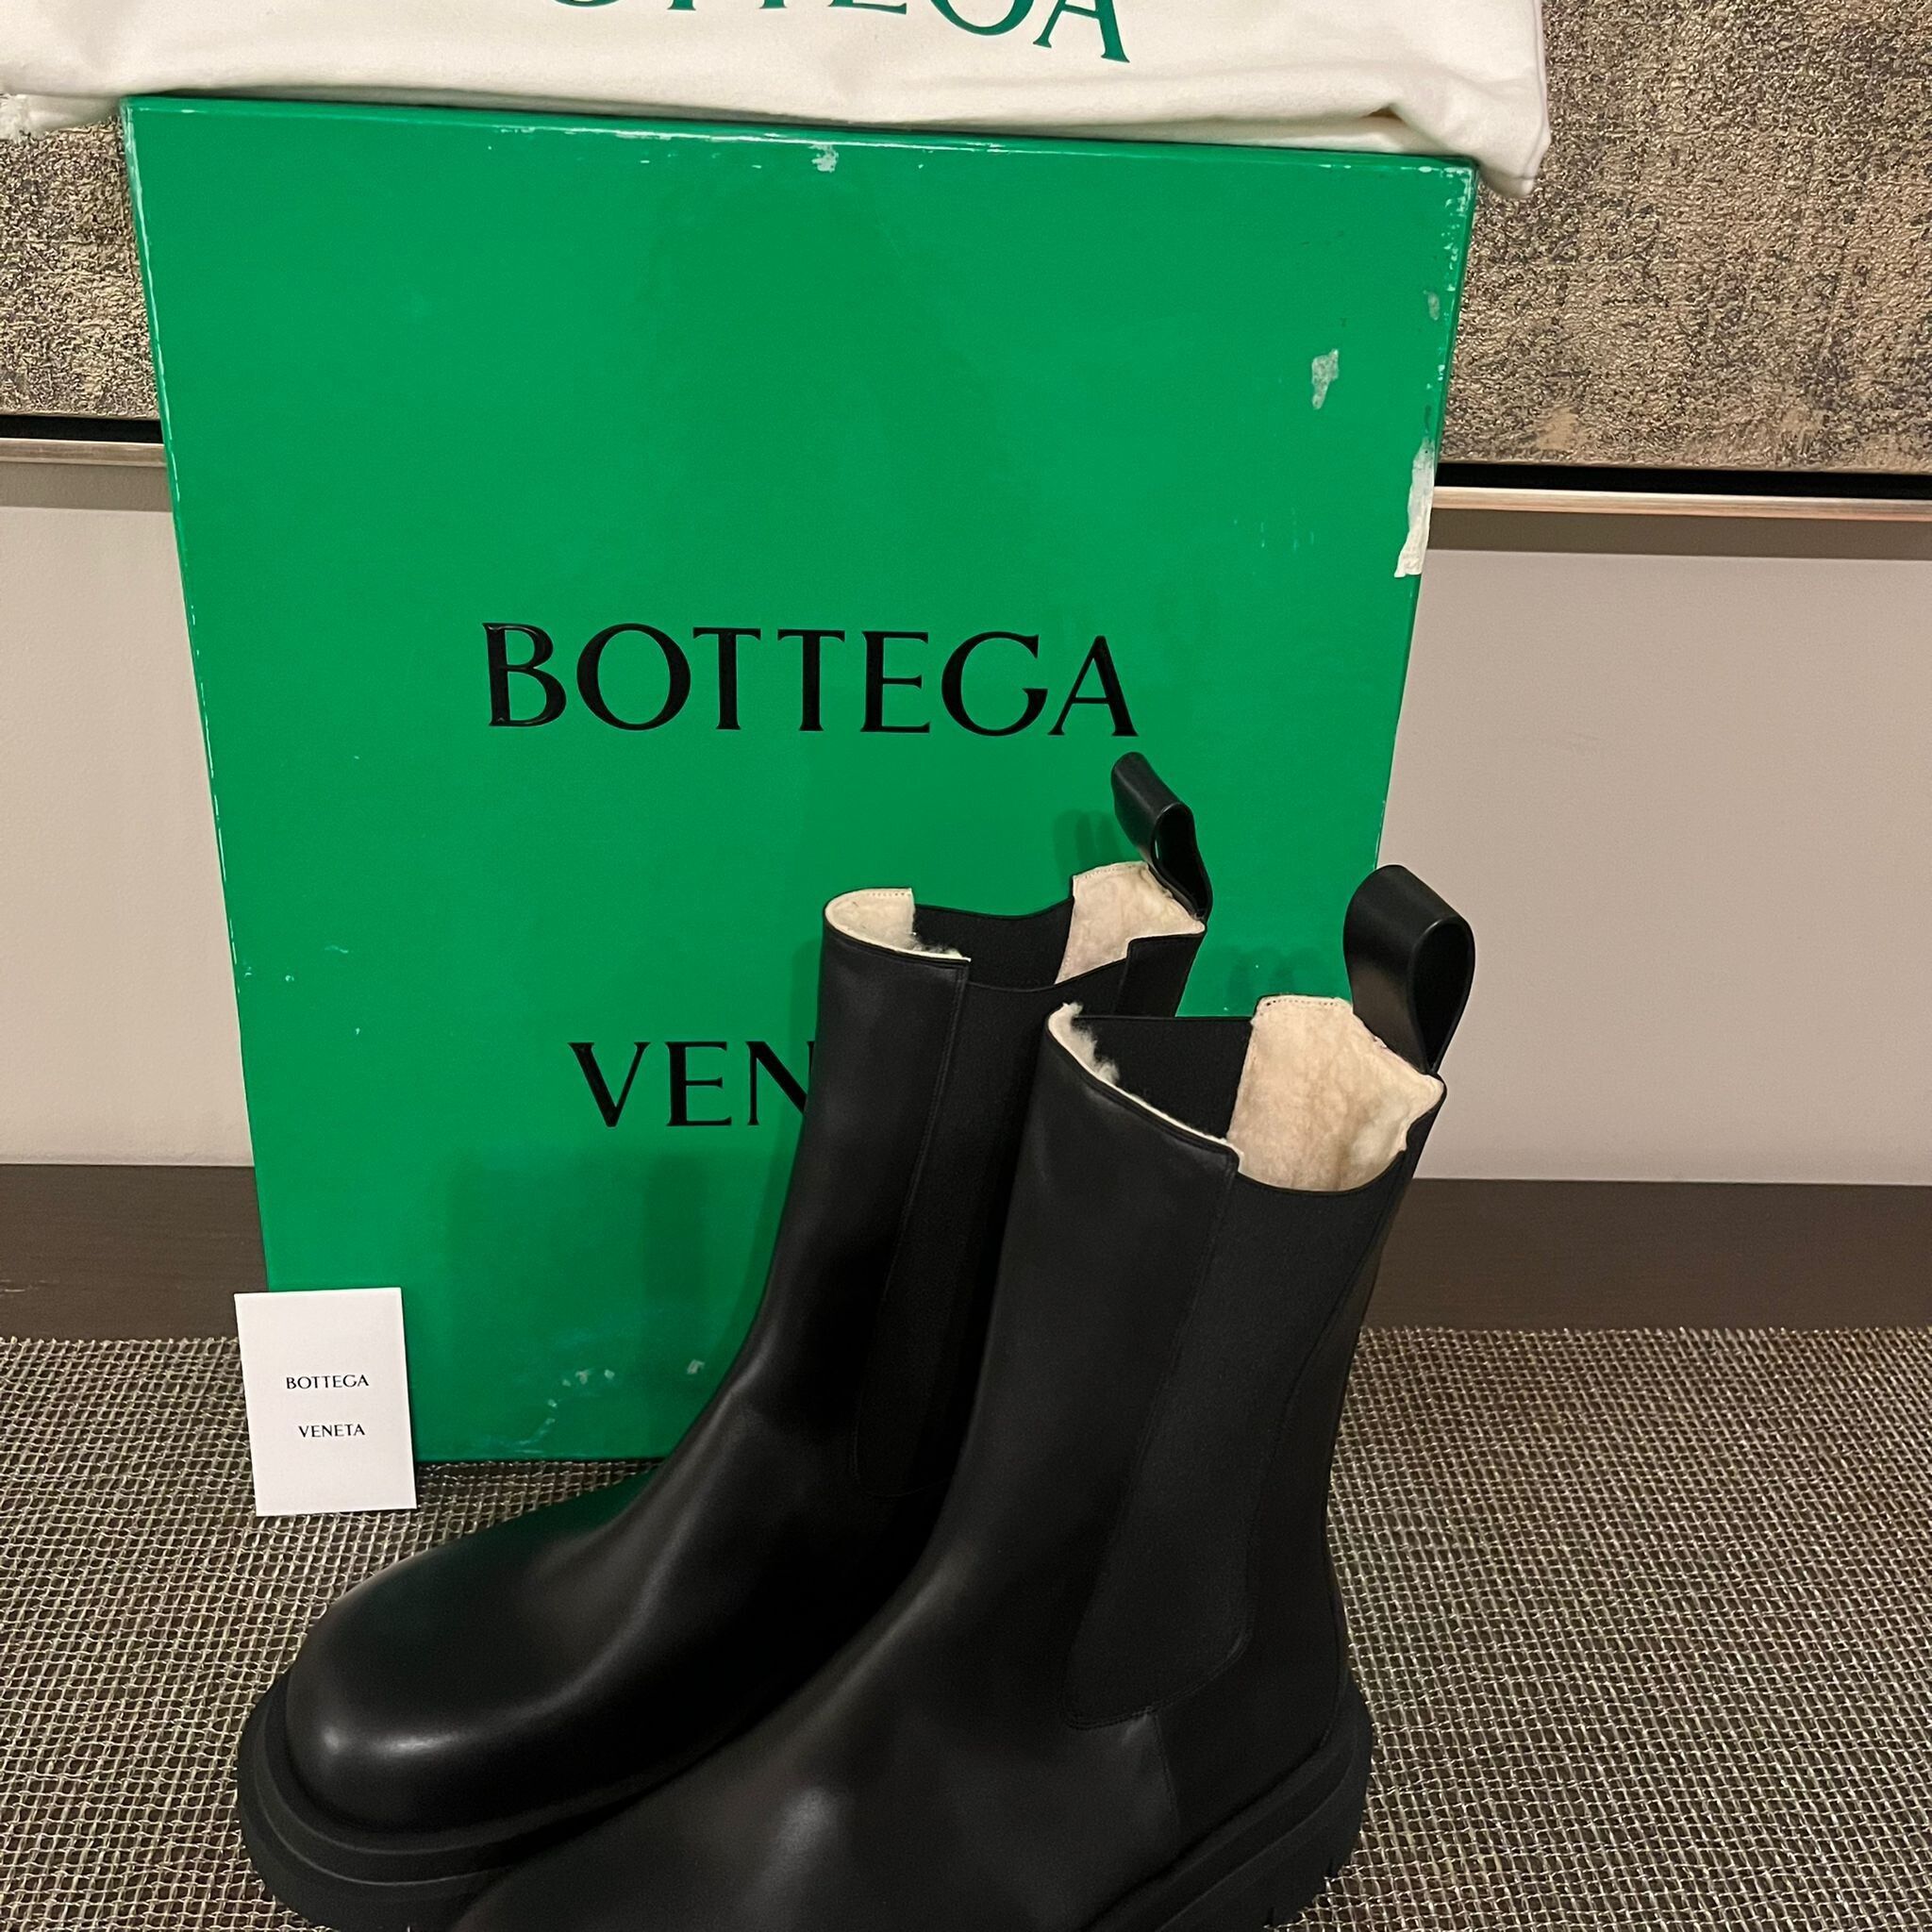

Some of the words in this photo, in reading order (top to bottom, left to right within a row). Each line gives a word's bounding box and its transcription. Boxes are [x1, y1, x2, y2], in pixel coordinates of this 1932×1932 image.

[482, 622, 1139, 738] BOTTEGA
[567, 1041, 815, 1128] VEN
[287, 1374, 369, 1389] BOTTEGA
[299, 1424, 365, 1438] VENETA
